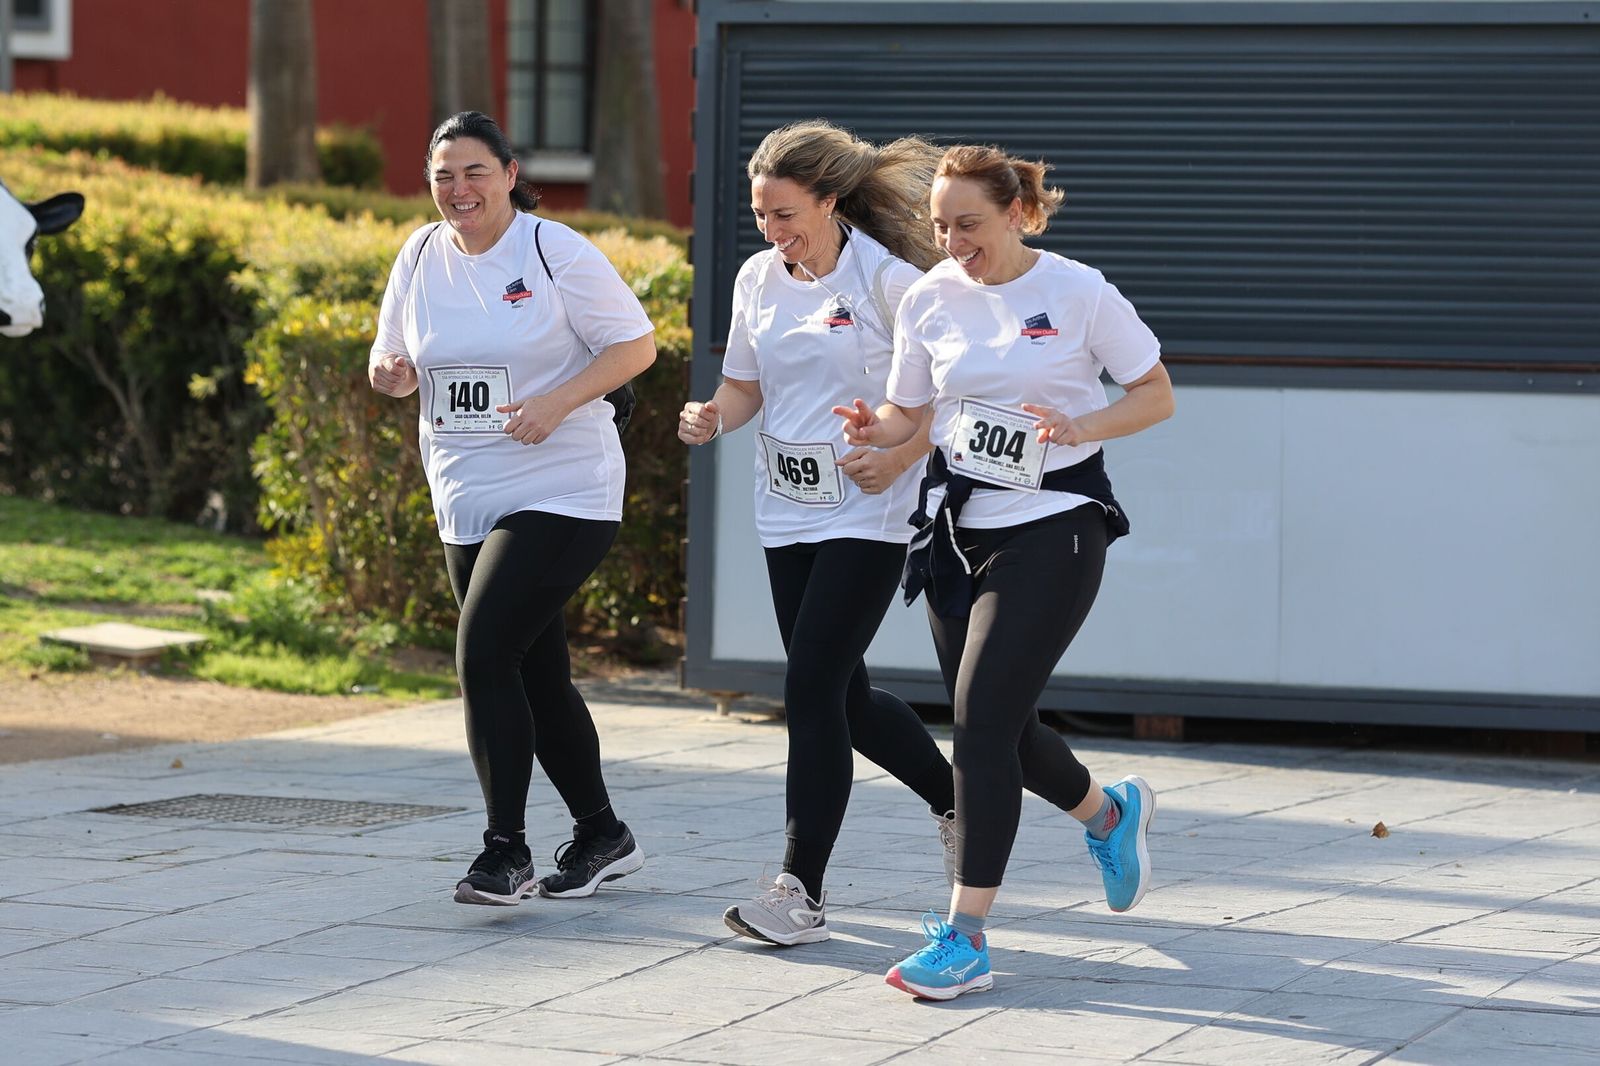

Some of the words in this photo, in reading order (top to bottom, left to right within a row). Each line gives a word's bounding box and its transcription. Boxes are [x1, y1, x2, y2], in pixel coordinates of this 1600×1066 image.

[448, 381, 489, 412] 140
[969, 421, 1027, 464] 304
[777, 452, 820, 486] 469
